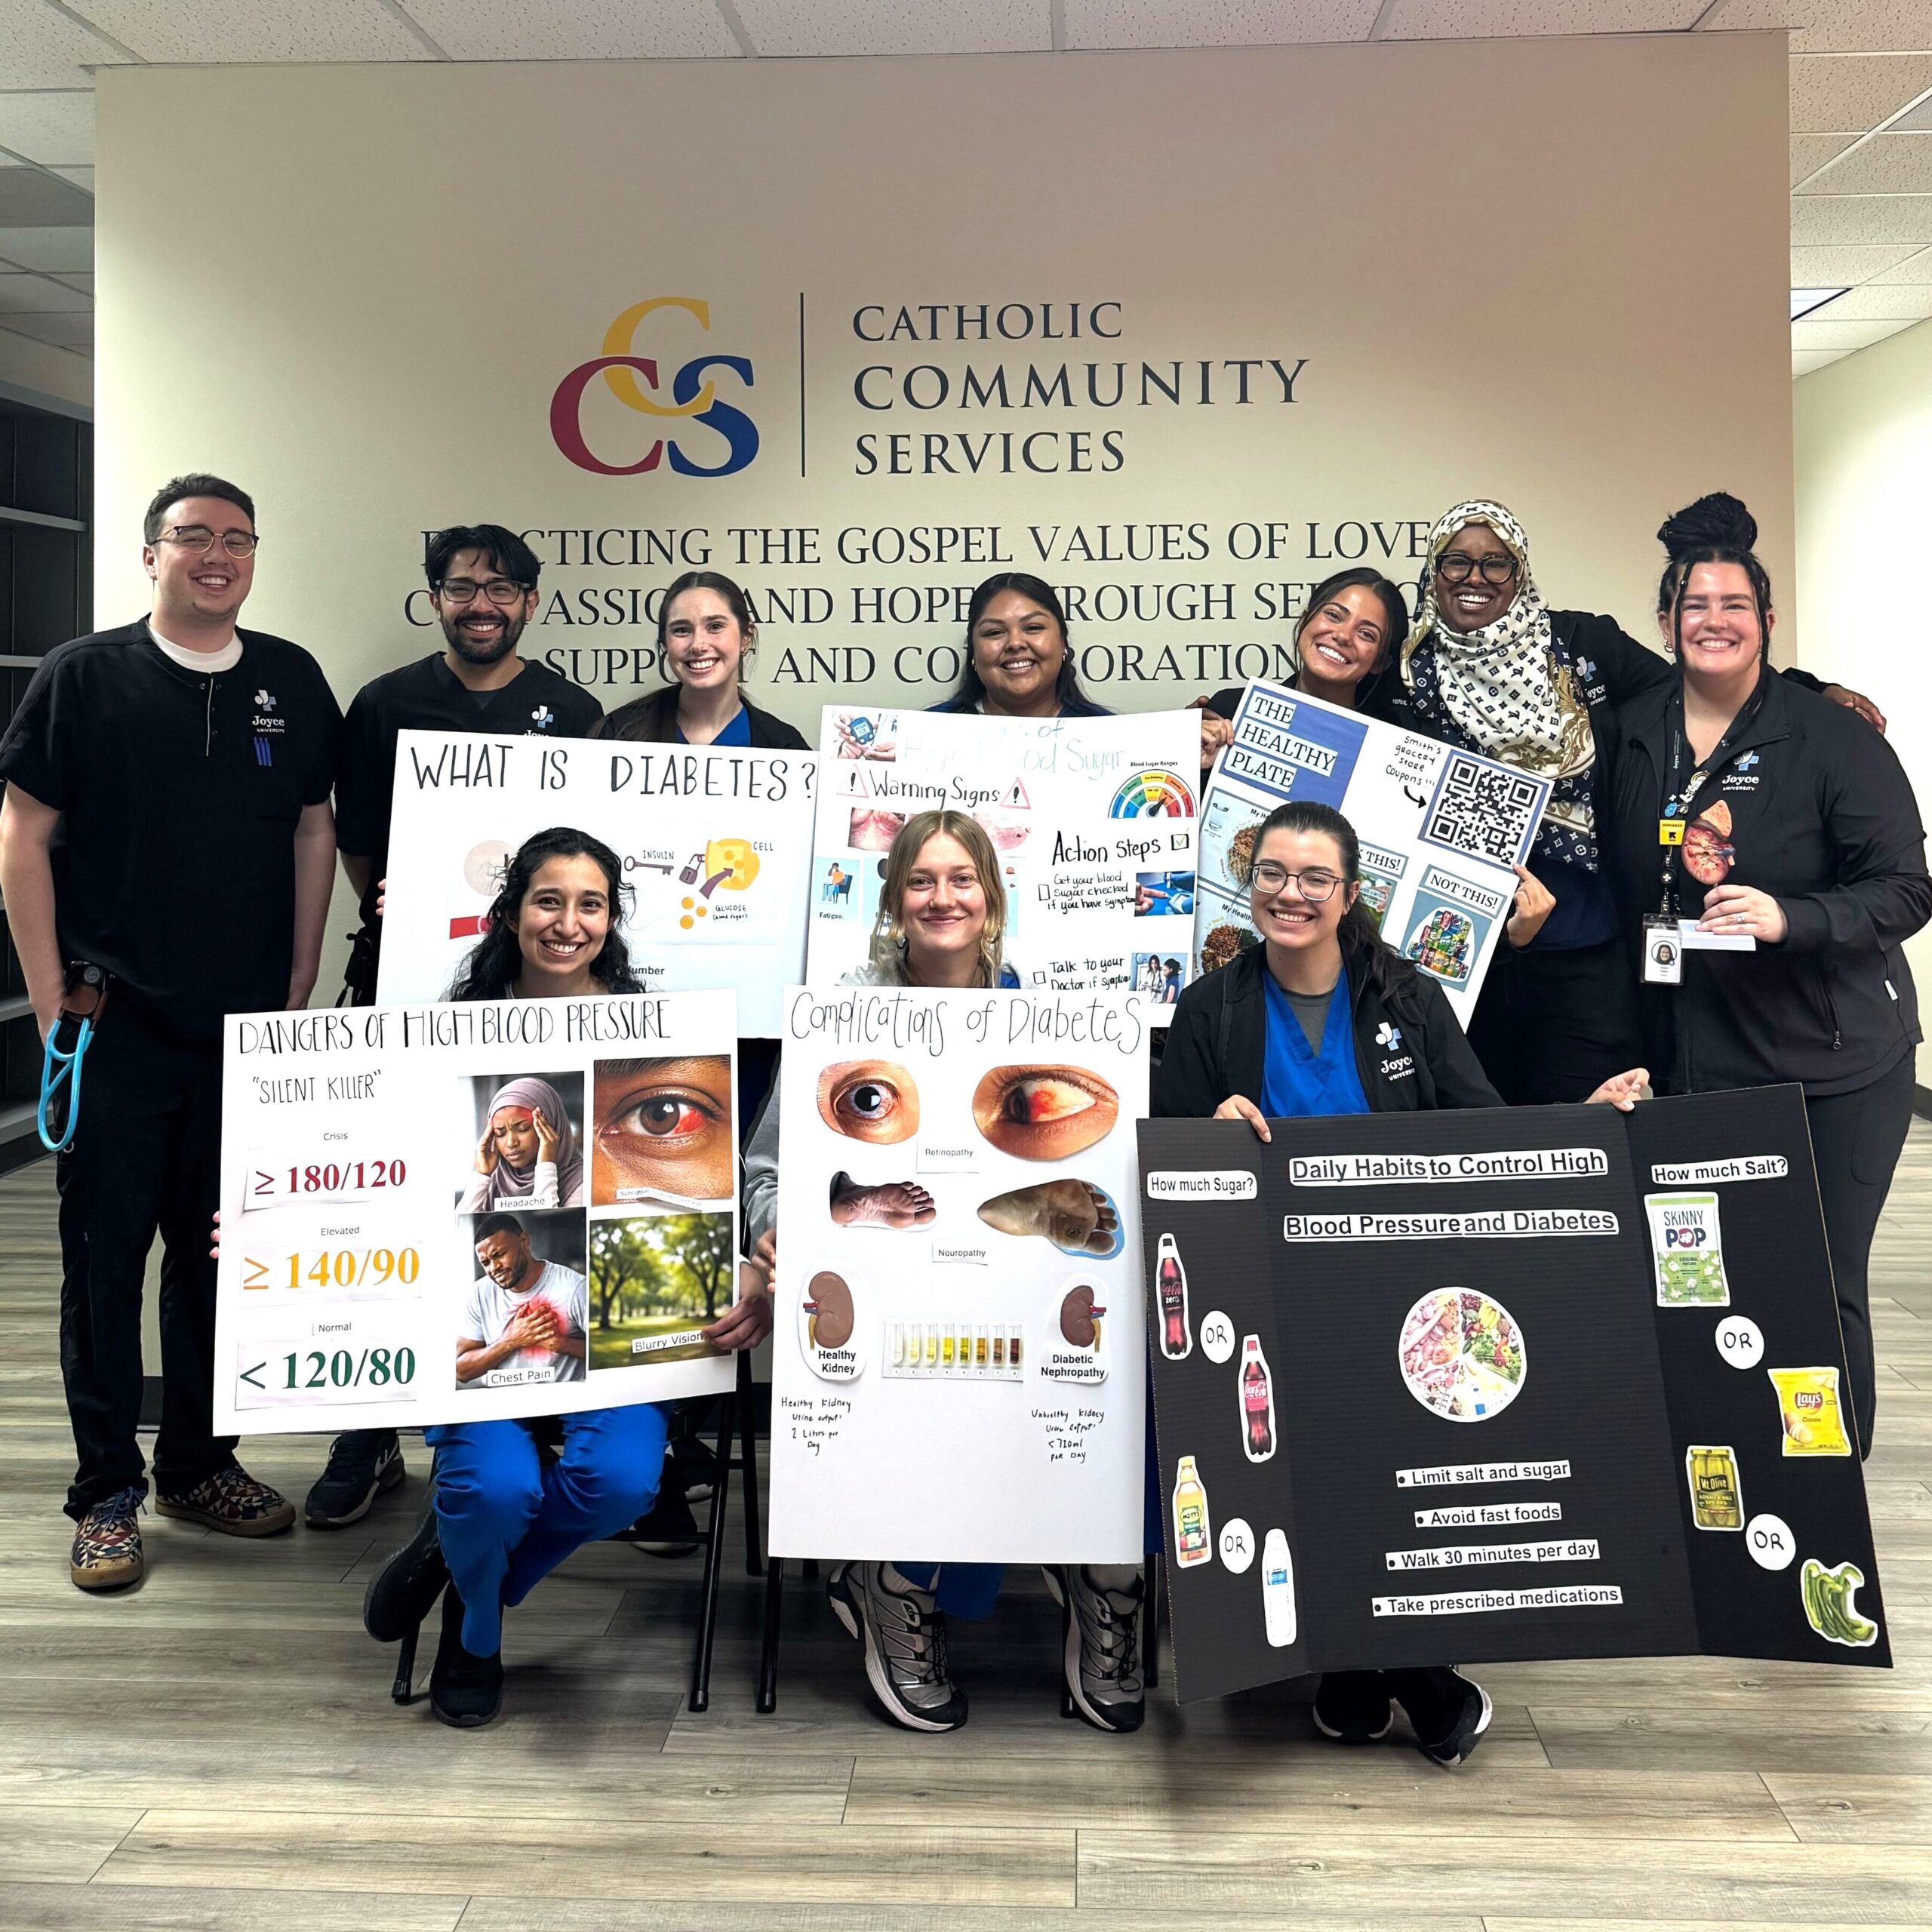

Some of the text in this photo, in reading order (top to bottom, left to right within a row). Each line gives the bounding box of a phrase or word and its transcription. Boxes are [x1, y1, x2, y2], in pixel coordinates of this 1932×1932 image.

[853, 302, 1123, 342] CATHOLIC
[854, 358, 1311, 411] COMMUNITY
[855, 430, 1124, 475] SERVICES
[728, 528, 821, 564] THE
[837, 526, 1013, 565] GOSPEL
[1027, 522, 1209, 562] VALUES
[1227, 521, 1289, 560] OF
[1306, 521, 1431, 558] LOVE
[405, 587, 670, 626] CASSIO
[851, 586, 975, 624] HOPE
[1052, 582, 1235, 622] ROUGH
[771, 647, 875, 684] AND
[894, 643, 1301, 684] COORATION
[1585, 684, 1606, 699] oyce
[1255, 697, 1294, 725] THE
[252, 715, 285, 728] Joyce
[1241, 723, 1337, 772] HEALTHY
[411, 743, 513, 789] WHAT
[540, 749, 568, 790] IS
[1066, 738, 1125, 780] Sugar
[1230, 751, 1295, 788] PLATE
[869, 769, 1000, 810] Warning Signs
[1722, 774, 1759, 786] Joyce
[642, 850, 674, 860] INSULIN
[753, 841, 774, 851] CELL
[1052, 830, 1161, 866] Action Steps
[1366, 851, 1401, 871] THIS!
[1054, 870, 1122, 889] Get your blood
[1088, 881, 1129, 896] checked
[1430, 874, 1499, 909] NOT THIS!
[1061, 901, 1079, 915] you
[1081, 898, 1102, 909] have
[1221, 903, 1232, 914] My
[1048, 958, 1125, 974] Talk to your
[1051, 977, 1086, 990] Doctor
[239, 999, 672, 1054] DANGERS OF HIGH BLOOD PRESSURE
[791, 991, 948, 1057] Complications
[966, 999, 997, 1042] of
[1380, 1056, 1414, 1074] Joyc
[1389, 1067, 1416, 1081] UNIVERSIT
[323, 1132, 348, 1141] Crisis
[924, 1148, 974, 1158] Retinopathy
[287, 1159, 407, 1194] 180/120
[1293, 1152, 1604, 1182] Daily Habits to Control High
[1654, 1158, 1786, 1183] How much Salt?
[1152, 1177, 1254, 1195] How much Sugar?
[500, 1196, 546, 1208] Headache
[321, 1226, 360, 1236] Elevated
[1286, 1211, 1615, 1236] Blood Pressure and Diabetes
[1665, 1227, 1707, 1248] POP
[938, 1249, 986, 1259] Neuropathy
[285, 1247, 420, 1289] 140/90
[318, 1322, 352, 1332] Normal
[1205, 1324, 1228, 1344] OR
[635, 1331, 703, 1352] Blurry Vision
[1724, 1331, 1753, 1349] OR
[818, 1350, 857, 1361] Healthy
[1053, 1354, 1094, 1364] Diabetic
[281, 1347, 416, 1389] 120/80
[491, 1368, 551, 1384] Chest Pain
[822, 1364, 856, 1376] Kidney
[1041, 1367, 1106, 1380] Nephropathy
[781, 1396, 851, 1413] Healthy Kidney
[1412, 1463, 1568, 1484] Limit salt and sugar
[1431, 1506, 1560, 1525] Avoid fast foods
[1225, 1535, 1246, 1554] OR
[1755, 1531, 1785, 1550] OR
[1401, 1542, 1596, 1568] Walk 30 minutes per day
[1388, 1588, 1619, 1614] Take prescribed medications
